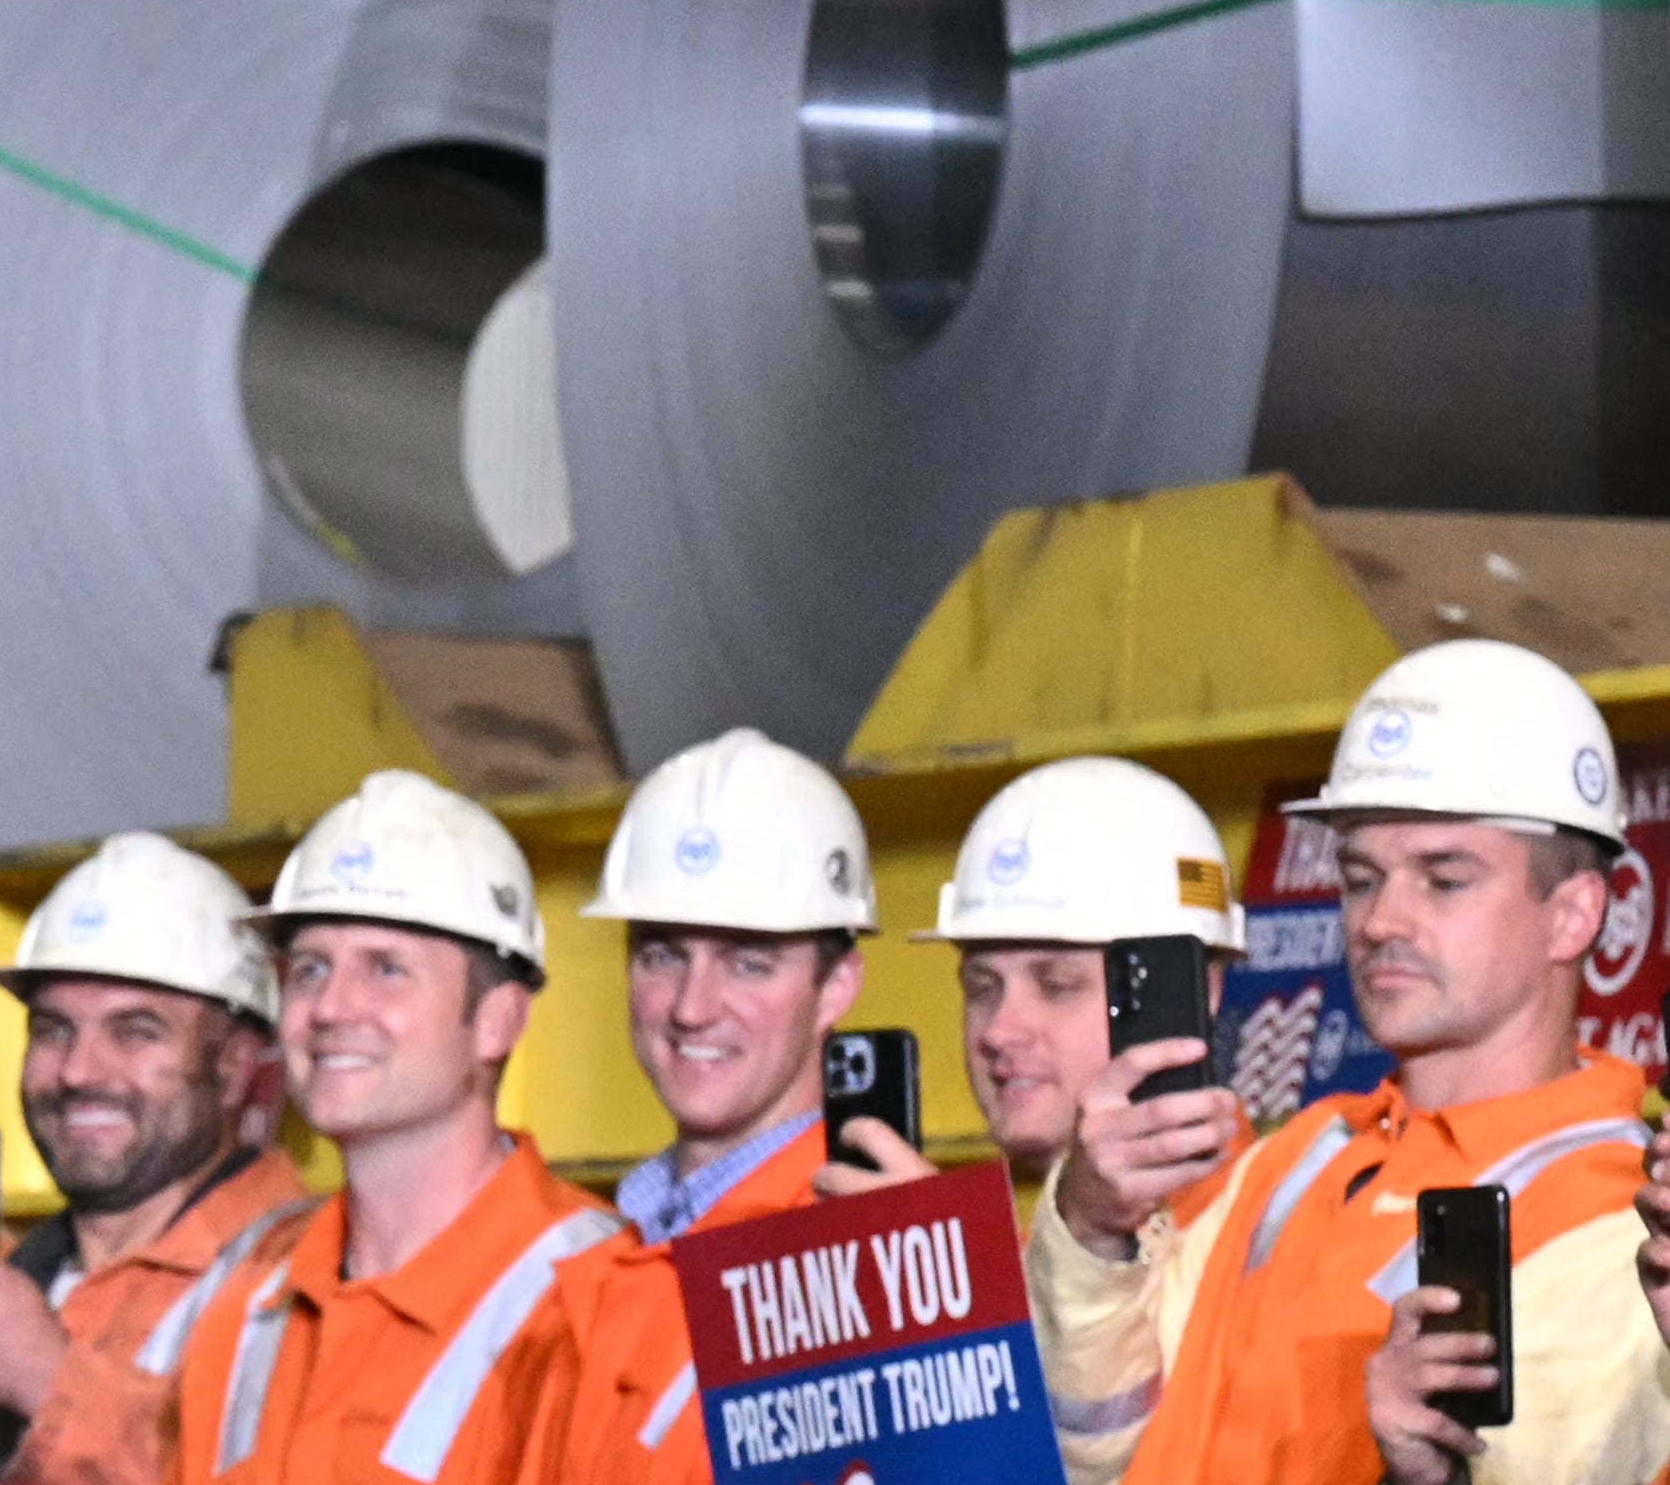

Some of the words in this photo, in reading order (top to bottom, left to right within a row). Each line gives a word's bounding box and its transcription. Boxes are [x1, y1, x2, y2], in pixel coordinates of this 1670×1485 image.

[719, 1238, 871, 1367] THANK
[869, 1214, 973, 1333] YOU
[721, 1363, 879, 1472] PRESIDENT
[880, 1338, 1021, 1435] TRUMP!
